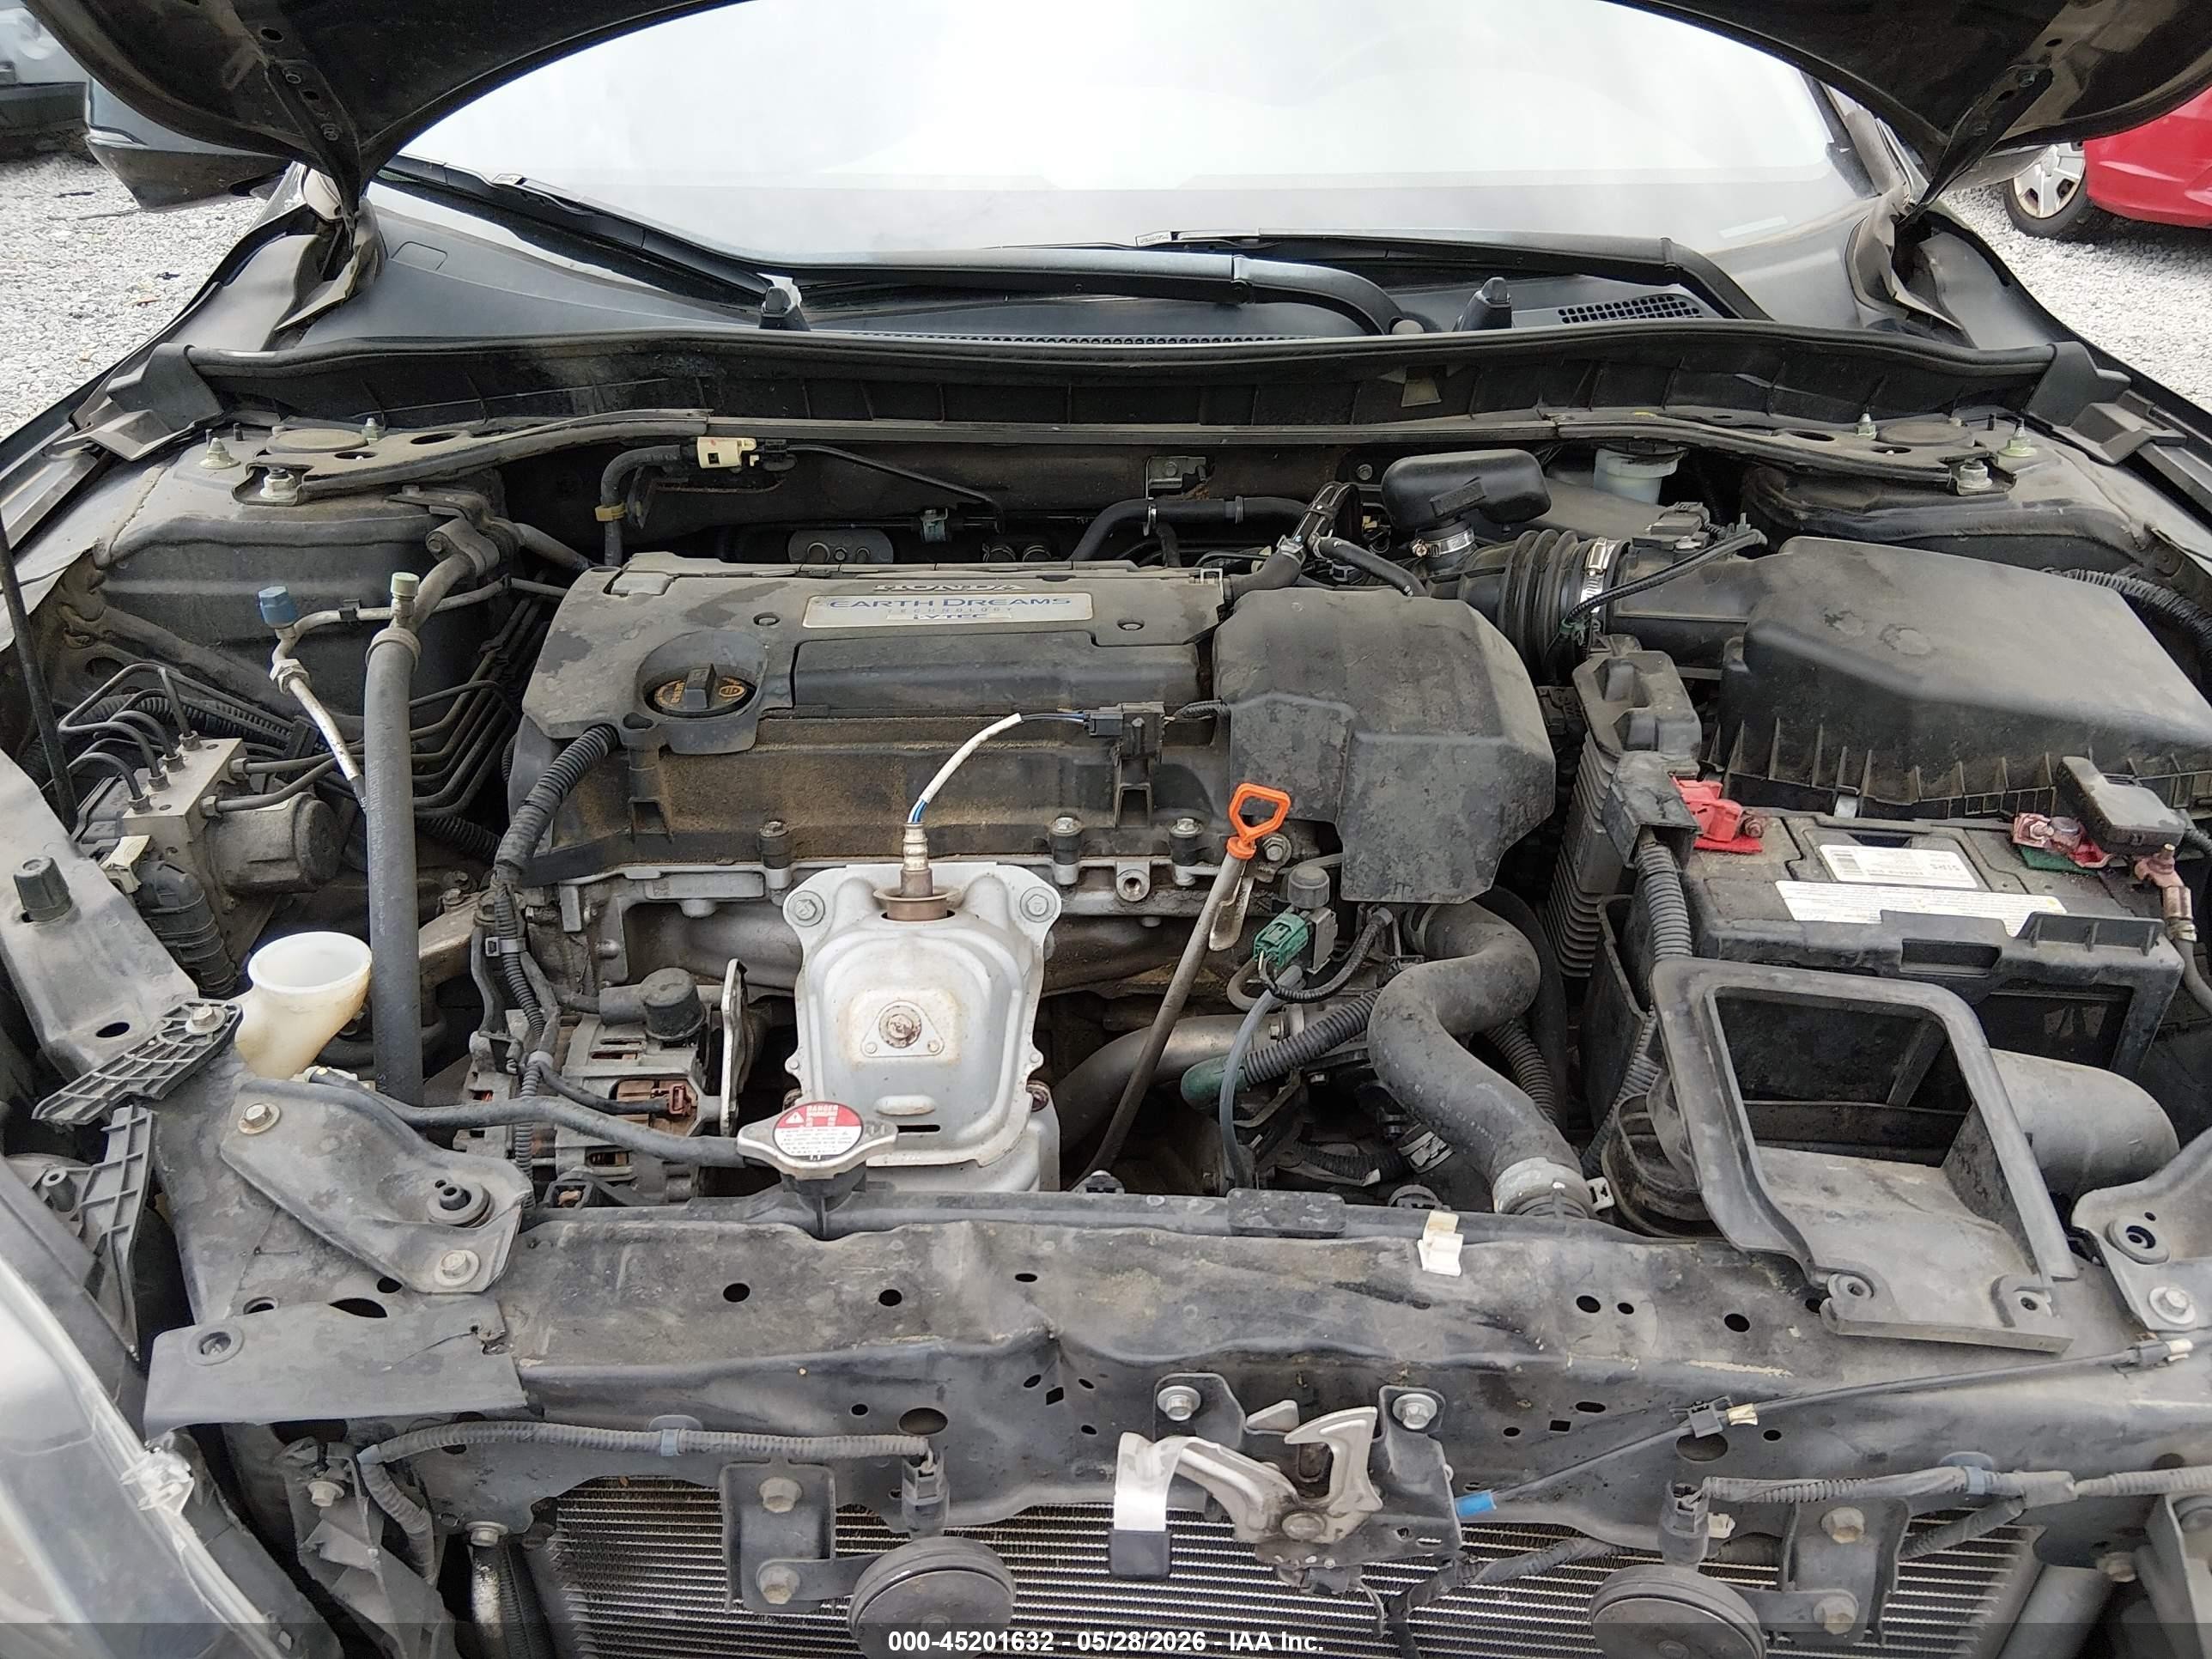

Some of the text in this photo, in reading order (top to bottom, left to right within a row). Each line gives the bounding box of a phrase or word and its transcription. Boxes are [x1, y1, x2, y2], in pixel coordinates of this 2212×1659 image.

[872, 583, 1028, 592] HONDA
[830, 597, 1072, 609] EARTH DREAMS
